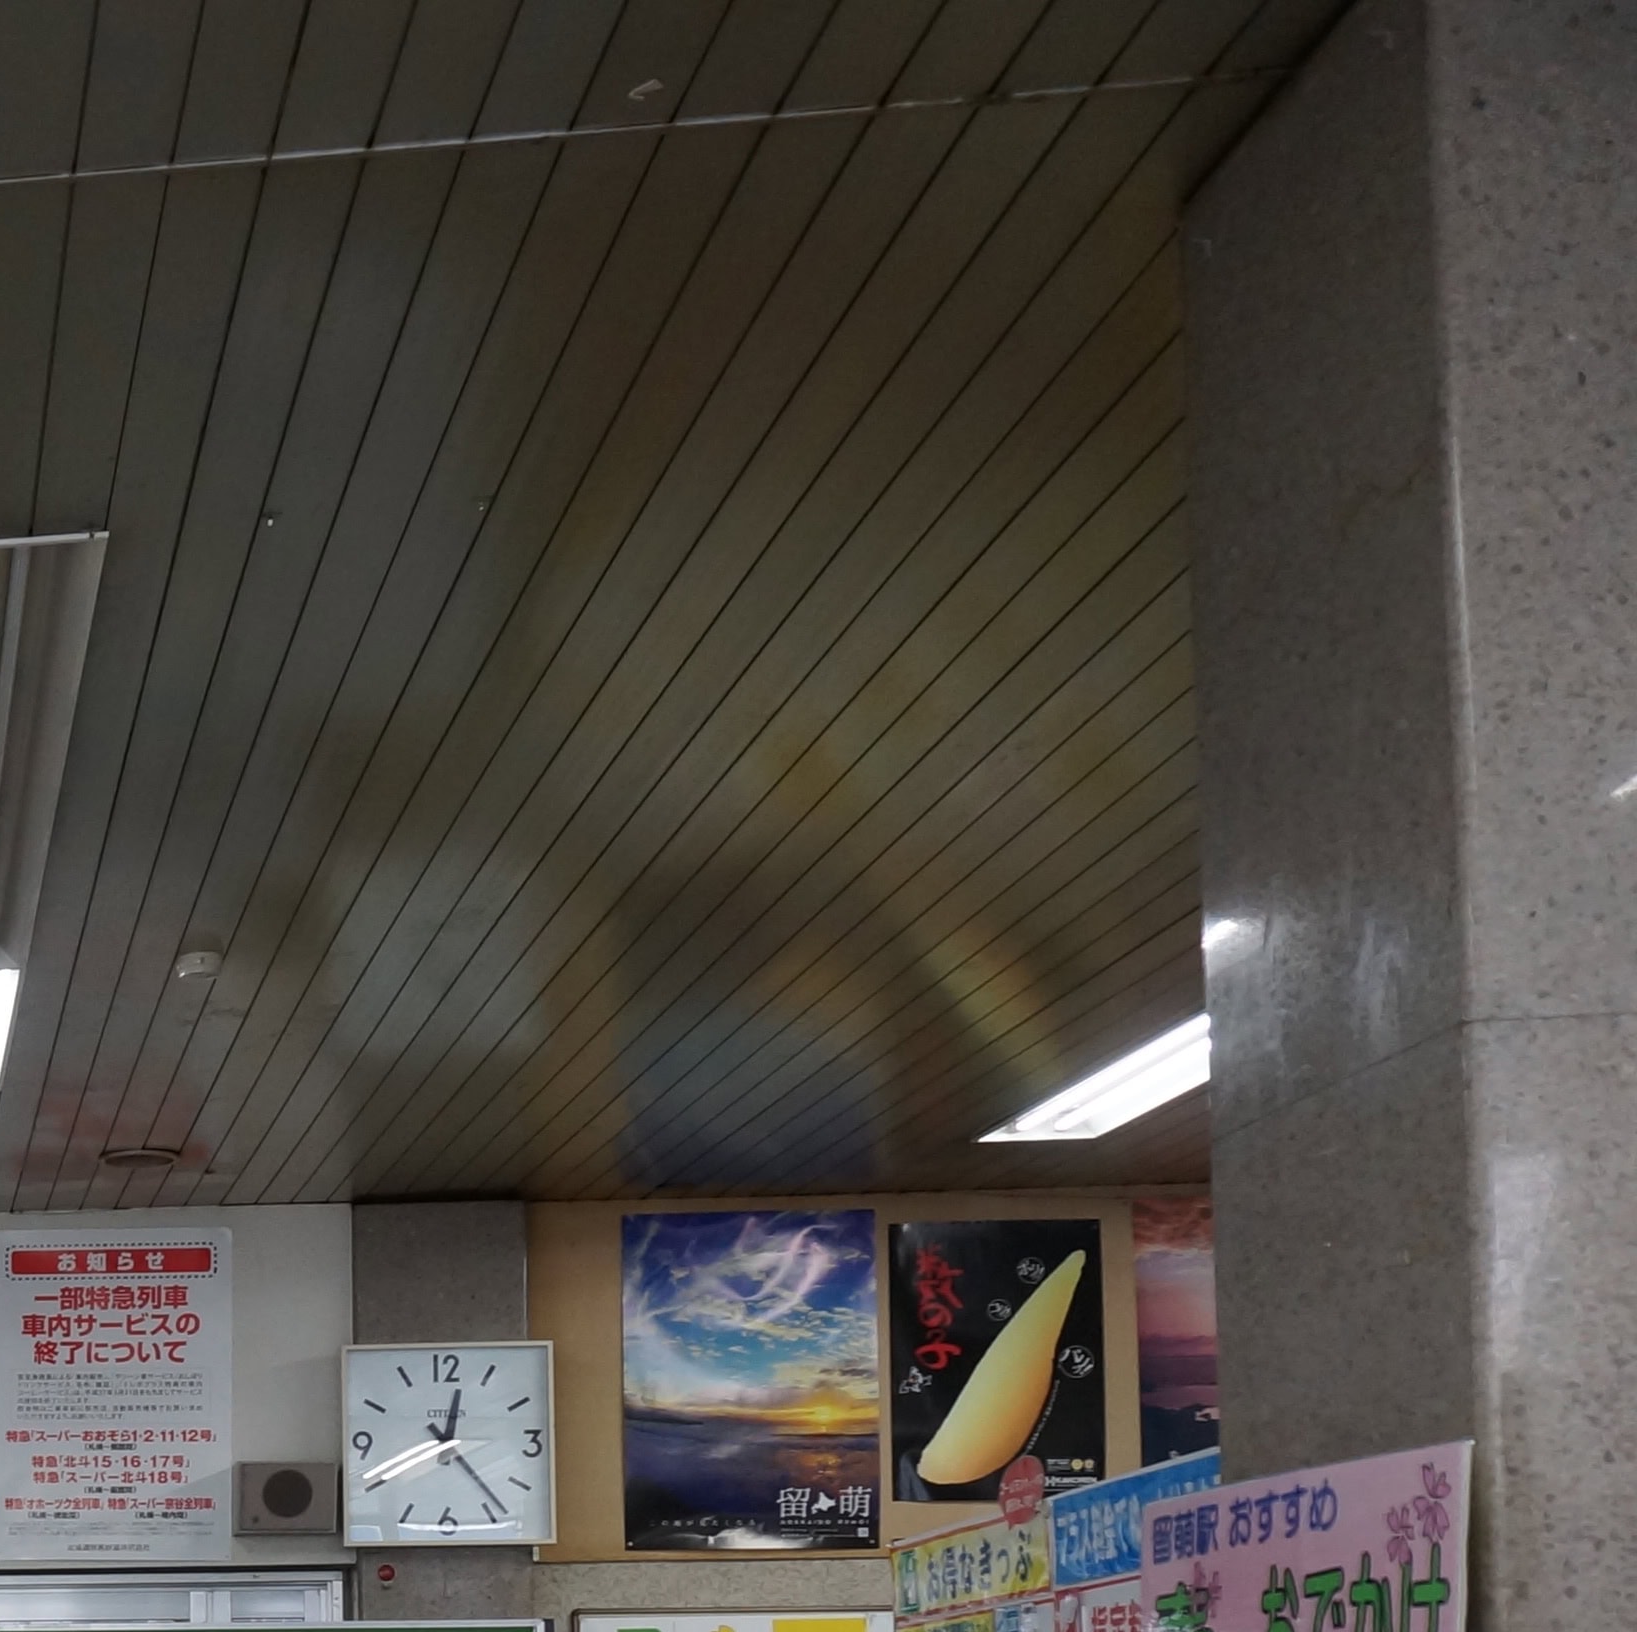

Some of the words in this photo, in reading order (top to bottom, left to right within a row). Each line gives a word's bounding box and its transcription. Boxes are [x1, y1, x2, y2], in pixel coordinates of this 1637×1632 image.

[57, 1253, 165, 1272] お知らせ
[34, 1286, 189, 1311] 一部特急列車
[21, 1312, 200, 1338] 車内サービスの
[34, 1341, 187, 1366] 終了について
[432, 1354, 461, 1383] 12
[426, 1408, 467, 1418] CITIN
[352, 1431, 373, 1460] 9
[522, 1429, 543, 1457] 3
[437, 1506, 458, 1535] 6
[1151, 1505, 1219, 1565] 留萌駅
[1229, 1480, 1339, 1546] おすすめ
[928, 1530, 1033, 1601] お得なきっぷ
